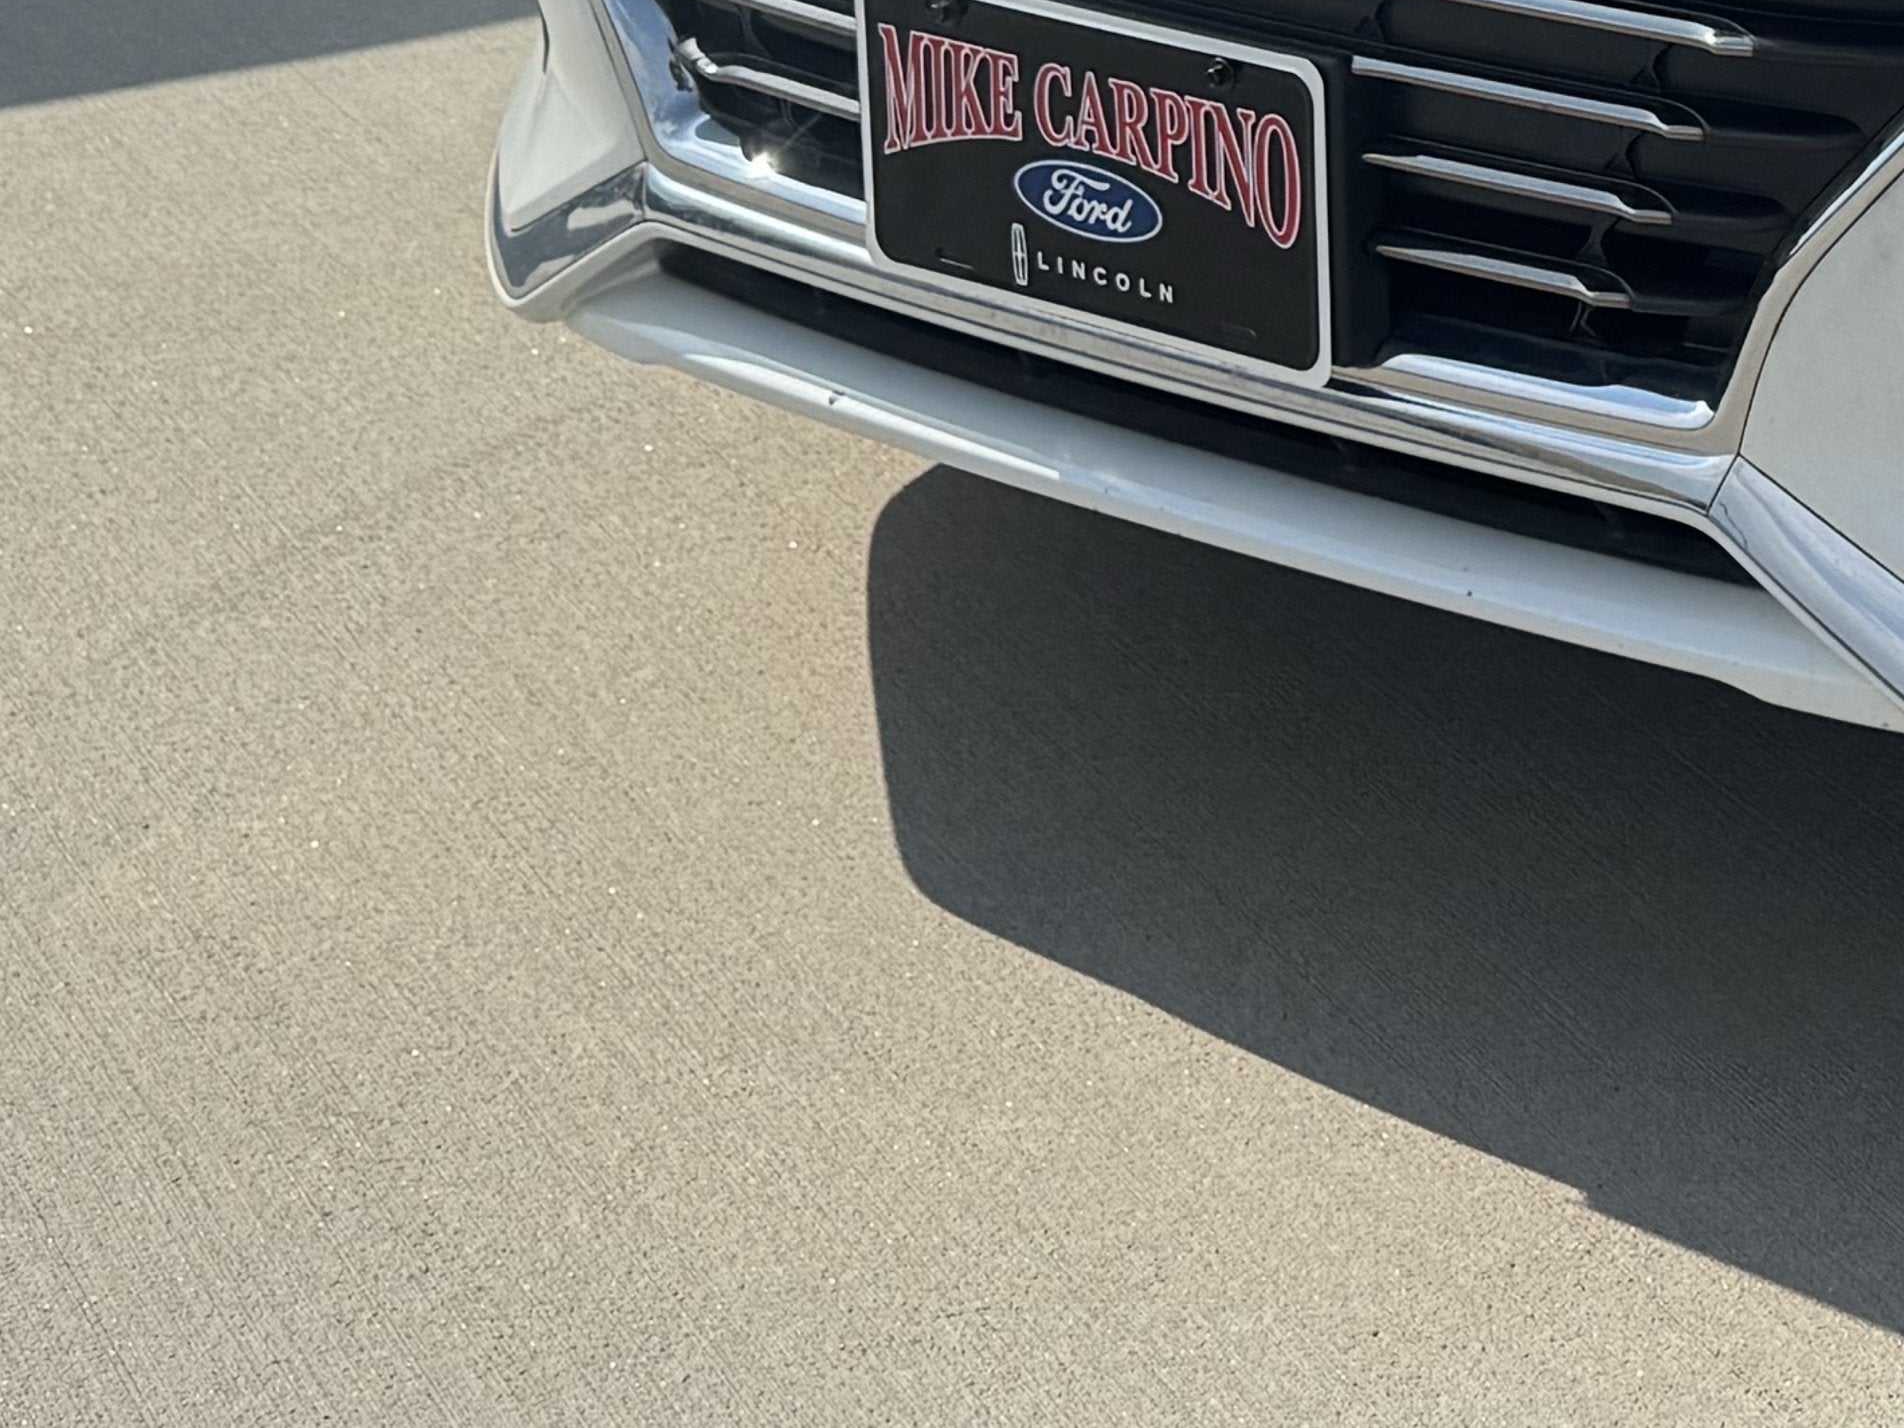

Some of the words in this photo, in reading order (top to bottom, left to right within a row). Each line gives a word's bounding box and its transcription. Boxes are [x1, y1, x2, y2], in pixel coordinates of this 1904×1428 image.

[877, 22, 1023, 155] MIKE
[1033, 62, 1301, 249] CARPINO
[1042, 168, 1134, 234] Ford
[1037, 251, 1173, 303] LINCOLN
